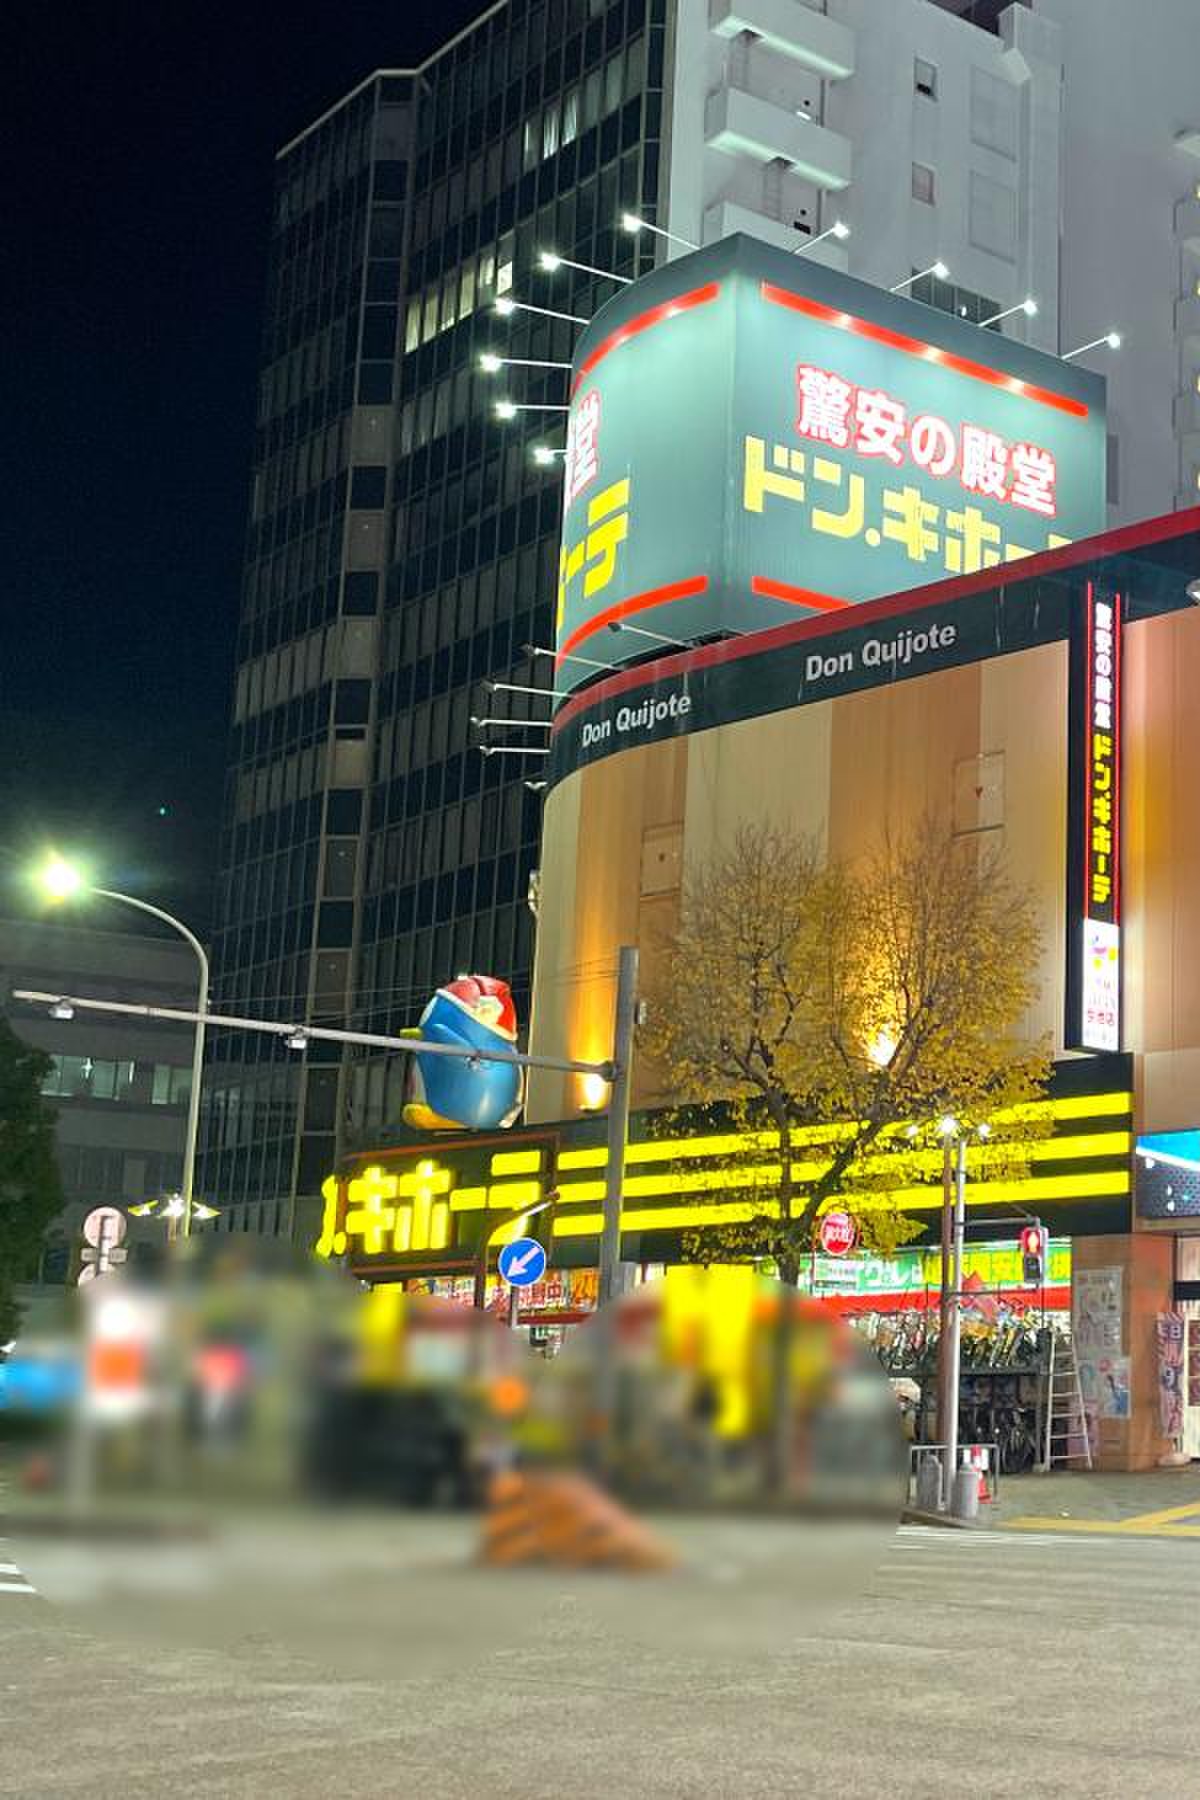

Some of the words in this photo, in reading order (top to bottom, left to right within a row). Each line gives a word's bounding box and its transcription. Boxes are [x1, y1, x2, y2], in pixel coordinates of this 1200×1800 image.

[797, 364, 1057, 518] 驚安の殿堂
[743, 435, 1073, 575] ドン.キホー
[805, 650, 854, 683] Don
[861, 623, 957, 670] Quijote
[582, 718, 611, 748] Don
[616, 693, 691, 732] Quijote
